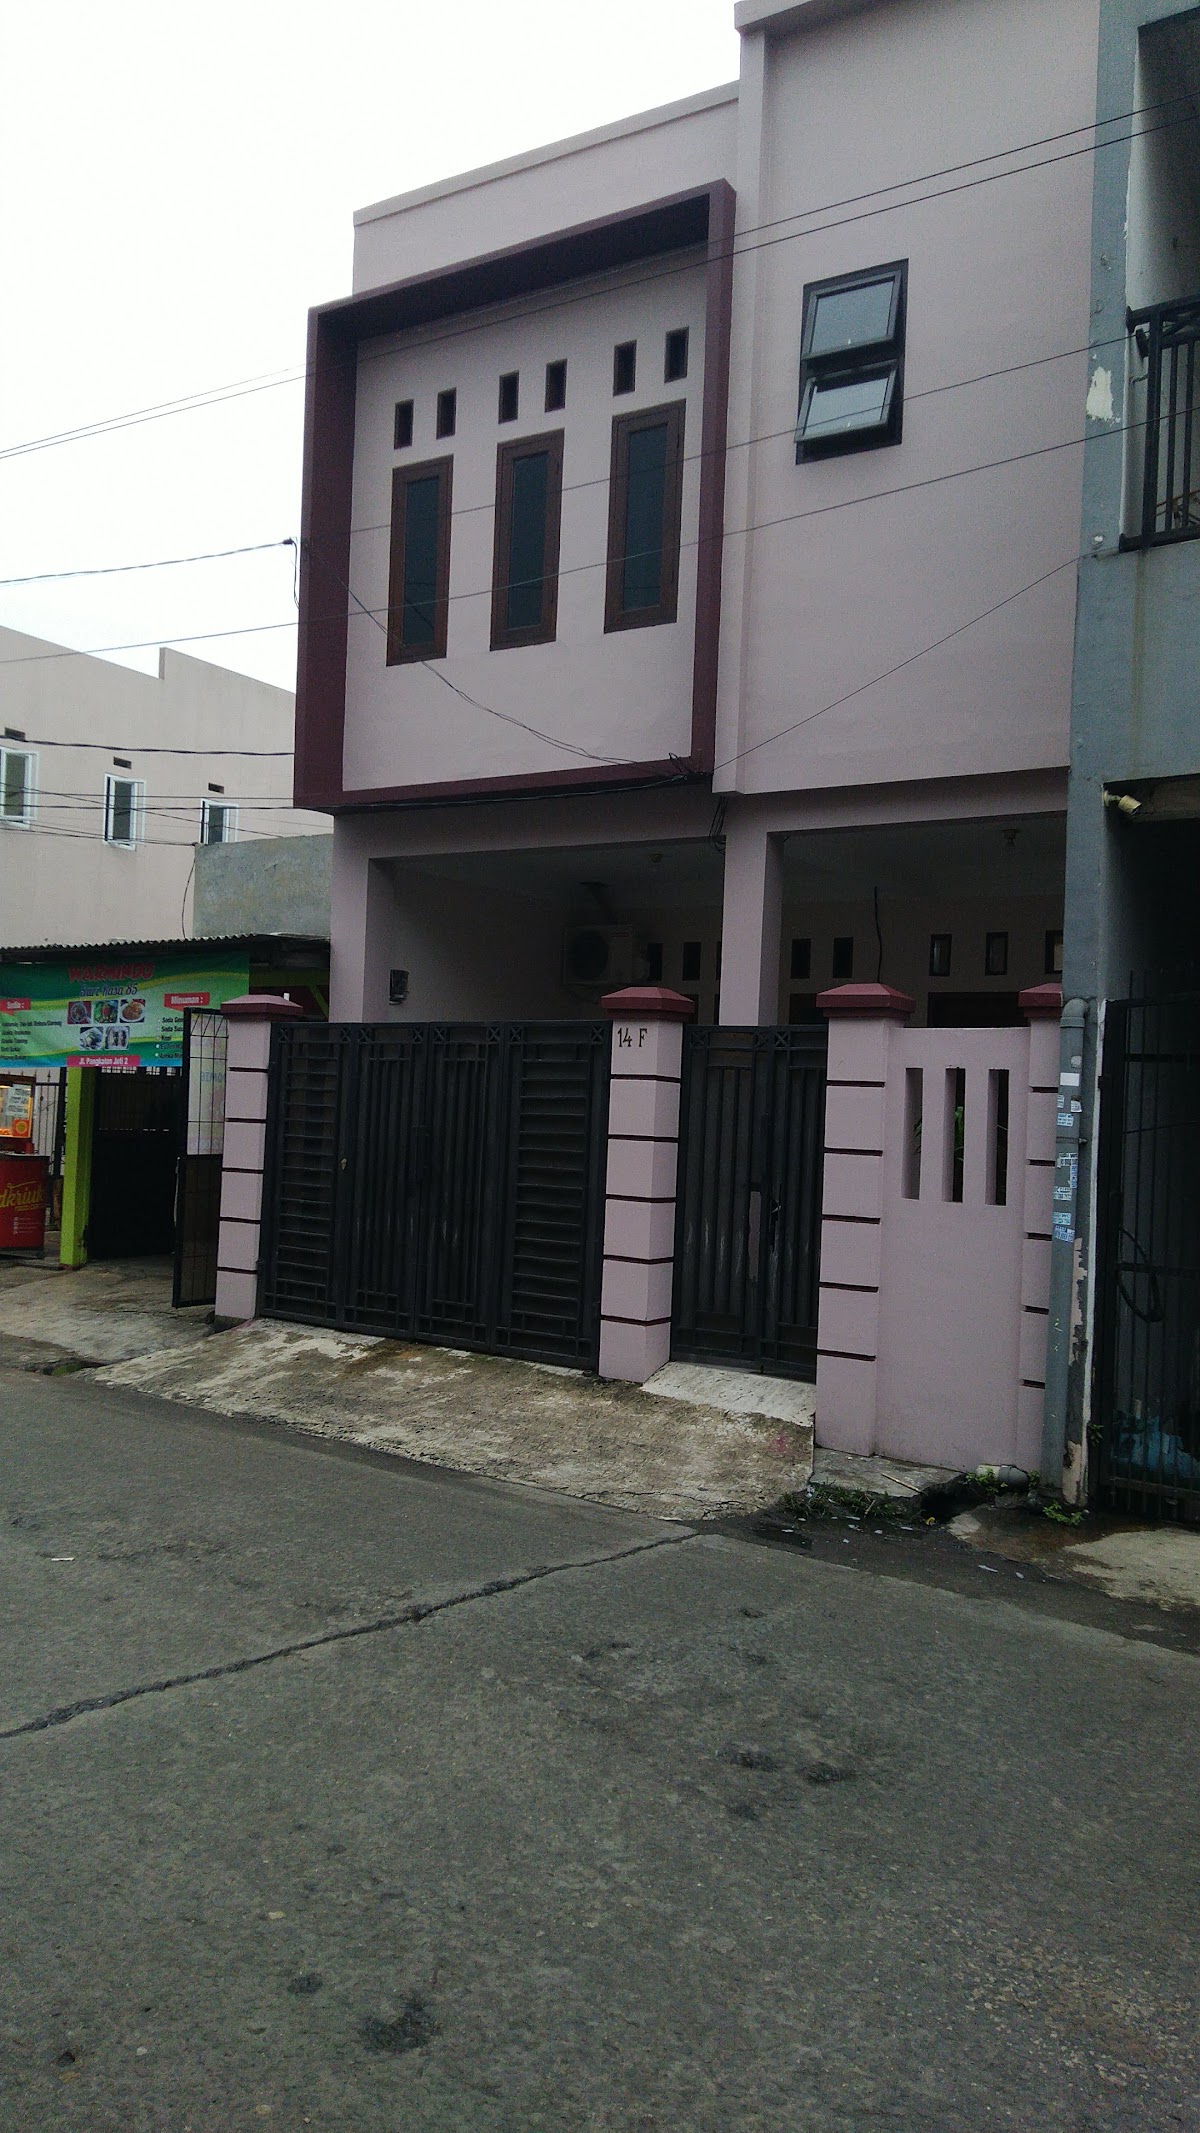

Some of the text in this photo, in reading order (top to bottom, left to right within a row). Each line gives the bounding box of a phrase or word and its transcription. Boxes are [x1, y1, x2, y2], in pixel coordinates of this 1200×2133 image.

[67, 962, 155, 982] WARMINDO
[126, 983, 138, 995] 85
[170, 996, 199, 1005] Minuman
[617, 1027, 648, 1048] 14 F
